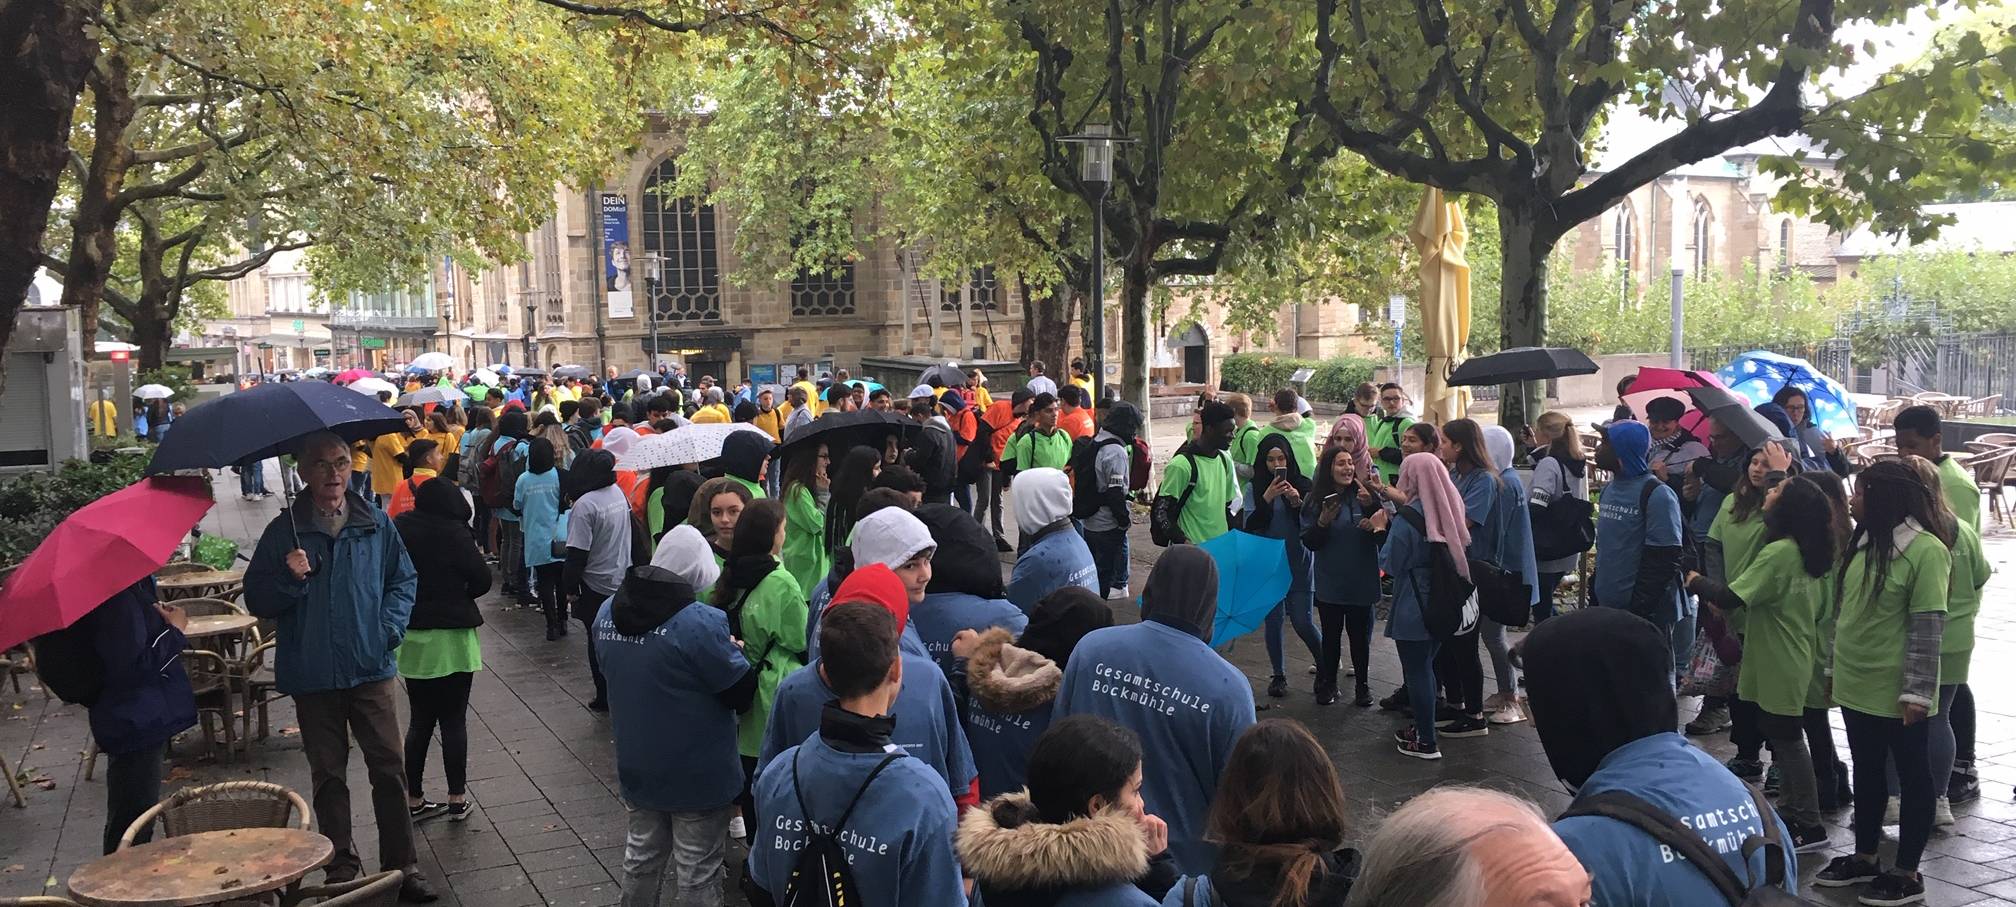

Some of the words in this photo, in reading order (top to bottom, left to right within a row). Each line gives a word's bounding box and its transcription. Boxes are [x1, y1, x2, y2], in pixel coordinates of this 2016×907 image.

[603, 196, 625, 205] DEIN
[1092, 679, 1176, 716] Bockmühle
[1095, 663, 1210, 713] Gesamtschule
